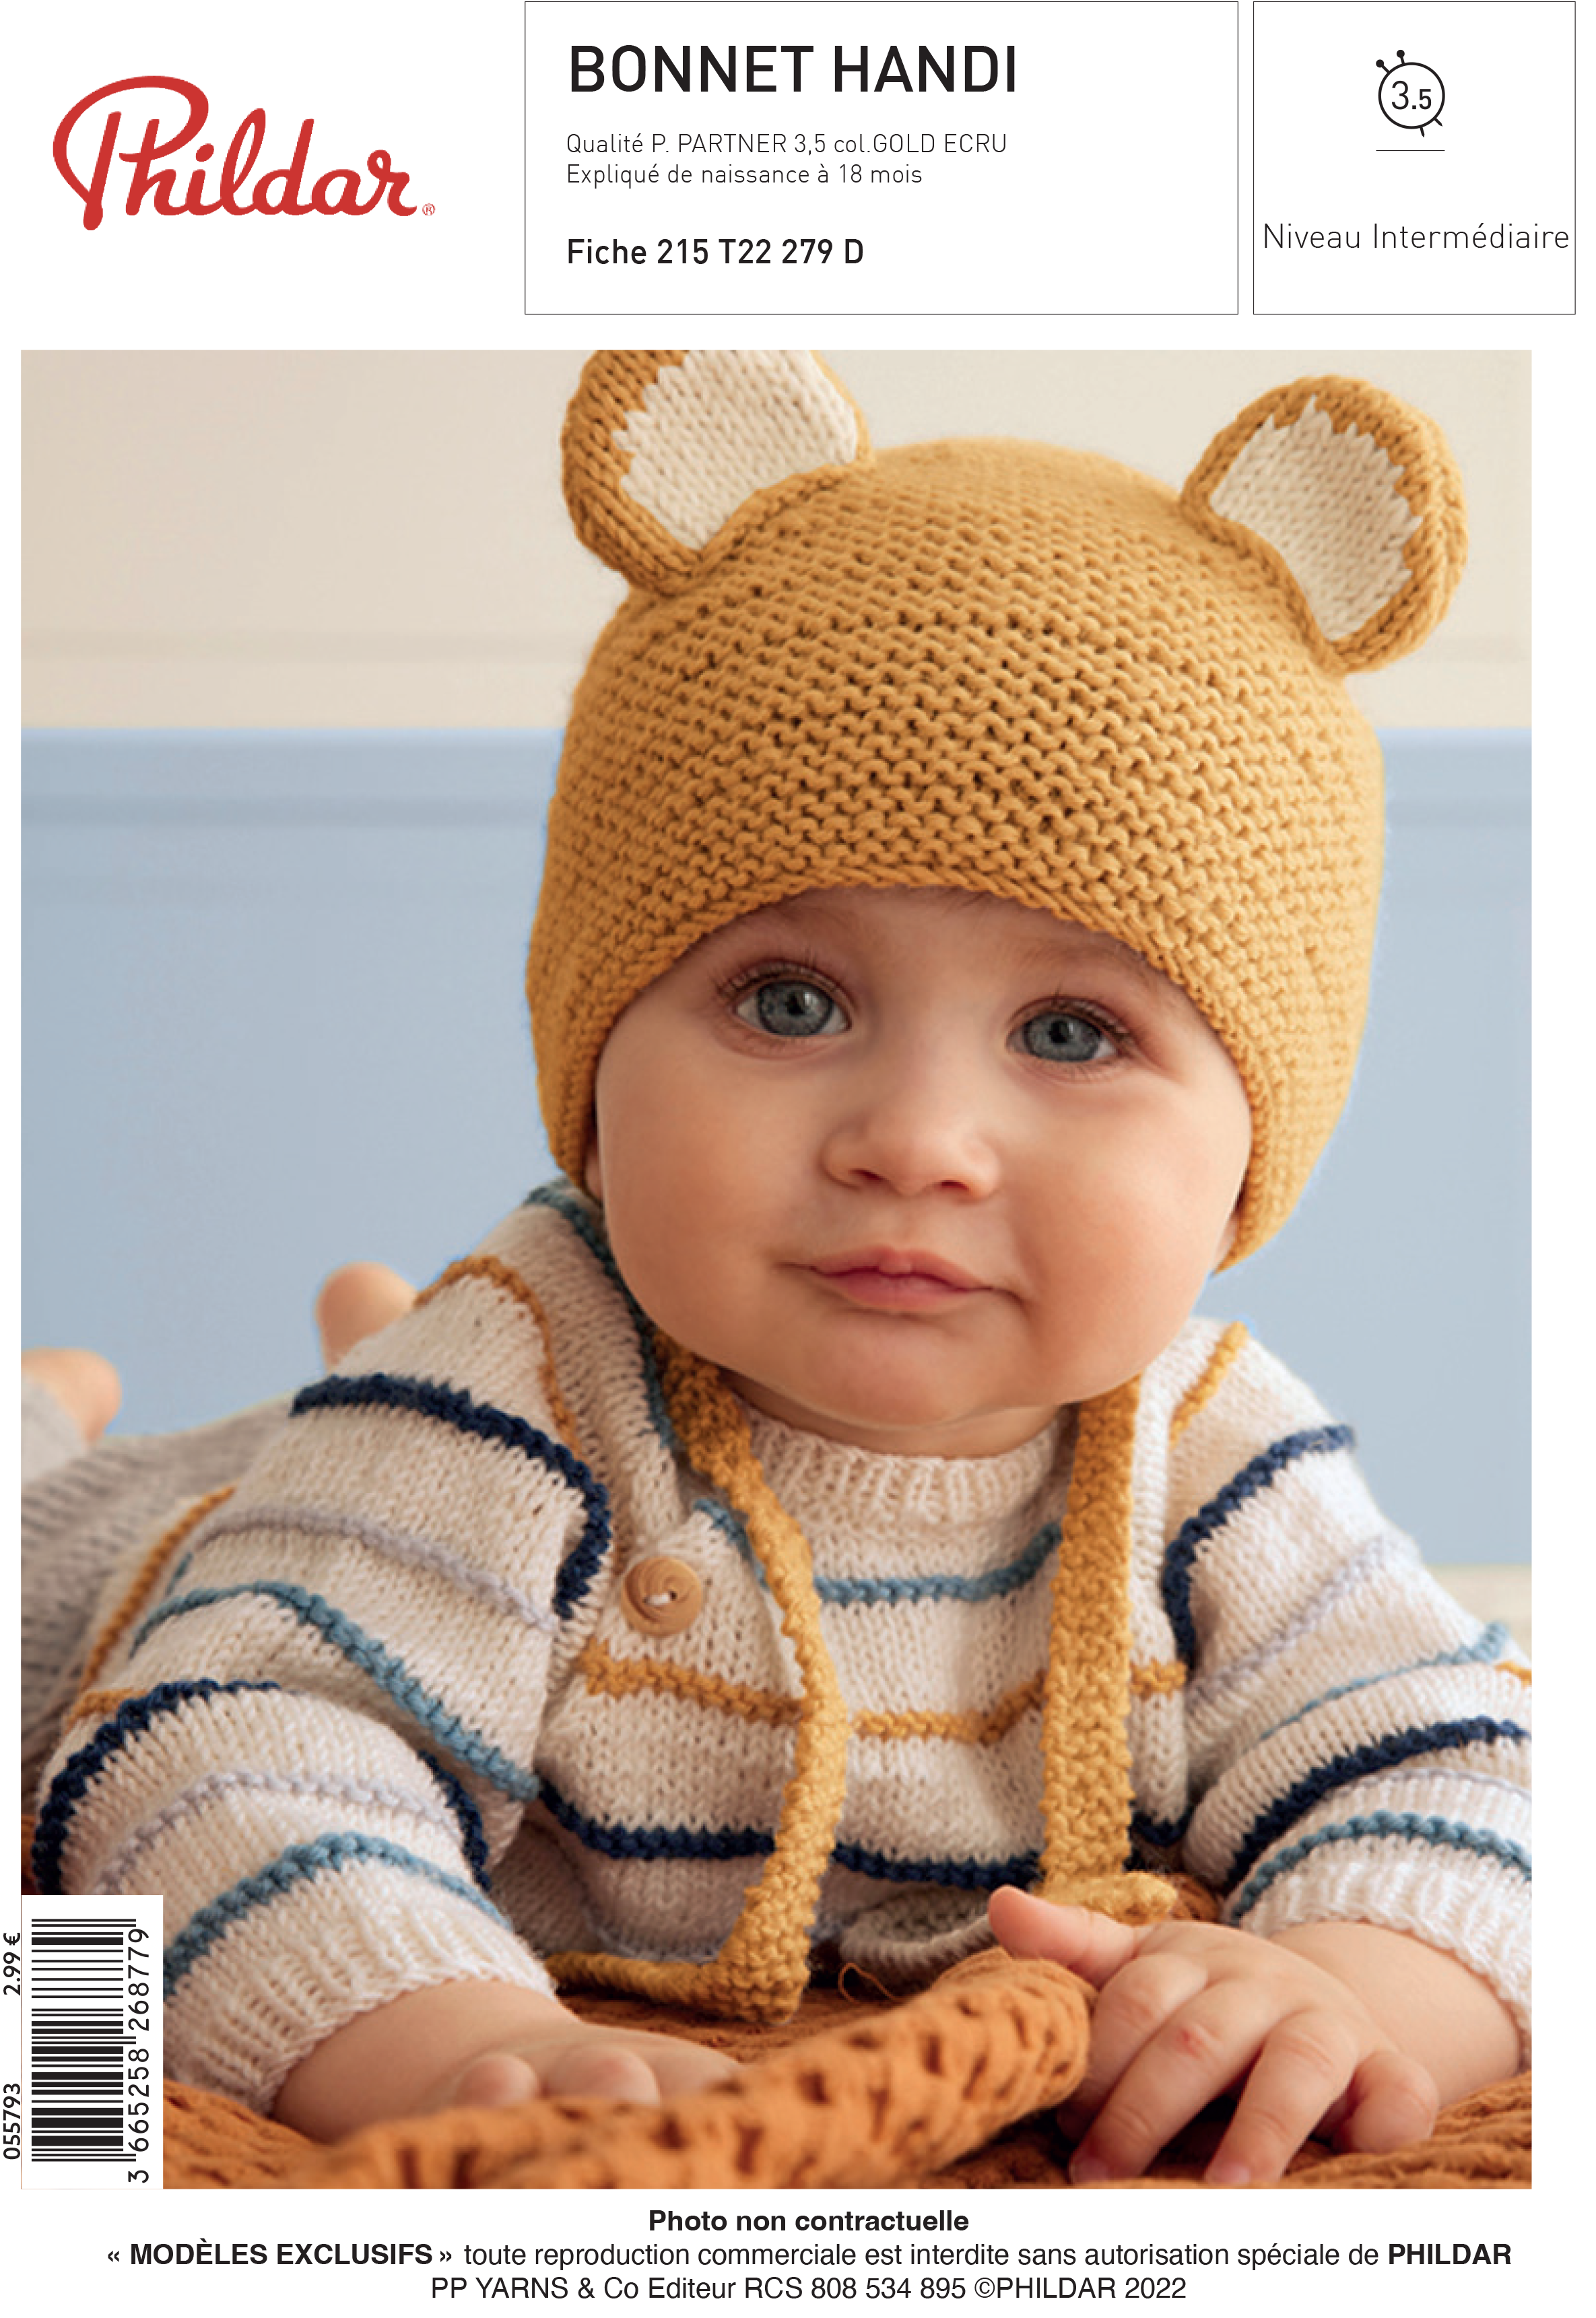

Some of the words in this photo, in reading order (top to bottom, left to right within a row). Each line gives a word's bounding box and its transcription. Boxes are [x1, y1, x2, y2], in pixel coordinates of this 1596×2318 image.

[570, 44, 814, 92] BONNET
[834, 45, 1015, 92] HANDI
[1391, 80, 1432, 110] 3.5
[567, 133, 643, 154] Qualité
[652, 133, 669, 153] P.
[678, 133, 787, 153] PARTNER
[794, 133, 826, 156] 3,5
[834, 133, 935, 153] col.GOLD
[945, 133, 1007, 153] ECRU
[568, 163, 659, 189] Expliqué
[667, 164, 692, 183] de
[702, 164, 809, 183] naissance
[818, 163, 828, 183] à
[840, 164, 862, 183] 18
[871, 164, 922, 183] mois
[1264, 223, 1360, 249] Niveau
[1374, 222, 1569, 249] Intermédiaire
[568, 238, 646, 265] Fiche
[657, 238, 708, 265] 215
[718, 238, 771, 264] T22
[782, 238, 833, 264] 279
[844, 238, 863, 264] D
[3, 1932, 21, 1946] €
[3, 1952, 21, 1996] 2.99
[128, 1928, 149, 2032] 268779
[128, 2049, 149, 2152] 665258
[3, 2083, 21, 2160] 055793
[128, 2170, 149, 2183] 3
[649, 2210, 727, 2231] Photo
[737, 2215, 786, 2231] non
[795, 2210, 969, 2231] contractuelle
[131, 2237, 268, 2265] MODÈLES
[277, 2243, 433, 2265] EXCLUSIFS
[463, 2245, 527, 2265] toute
[535, 2243, 690, 2271] reproduction
[698, 2243, 857, 2265] commerciale
[865, 2245, 902, 2265] est
[910, 2243, 1009, 2265] interdite
[1018, 2248, 1076, 2265] sans
[1084, 2243, 1229, 2265] autorisation
[1237, 2243, 1340, 2271] spéciale
[1348, 2243, 1379, 2265] de
[1389, 2243, 1512, 2265] PHILDAR
[432, 2277, 467, 2298] PP
[475, 2276, 568, 2299] YARNS
[604, 2276, 639, 2299] Co
[649, 2277, 737, 2299] Editeur
[745, 2276, 803, 2299] RCS
[811, 2277, 857, 2299] 808
[865, 2277, 912, 2299] 534
[920, 2277, 966, 2299] 895
[1125, 2277, 1187, 2299] 2022
